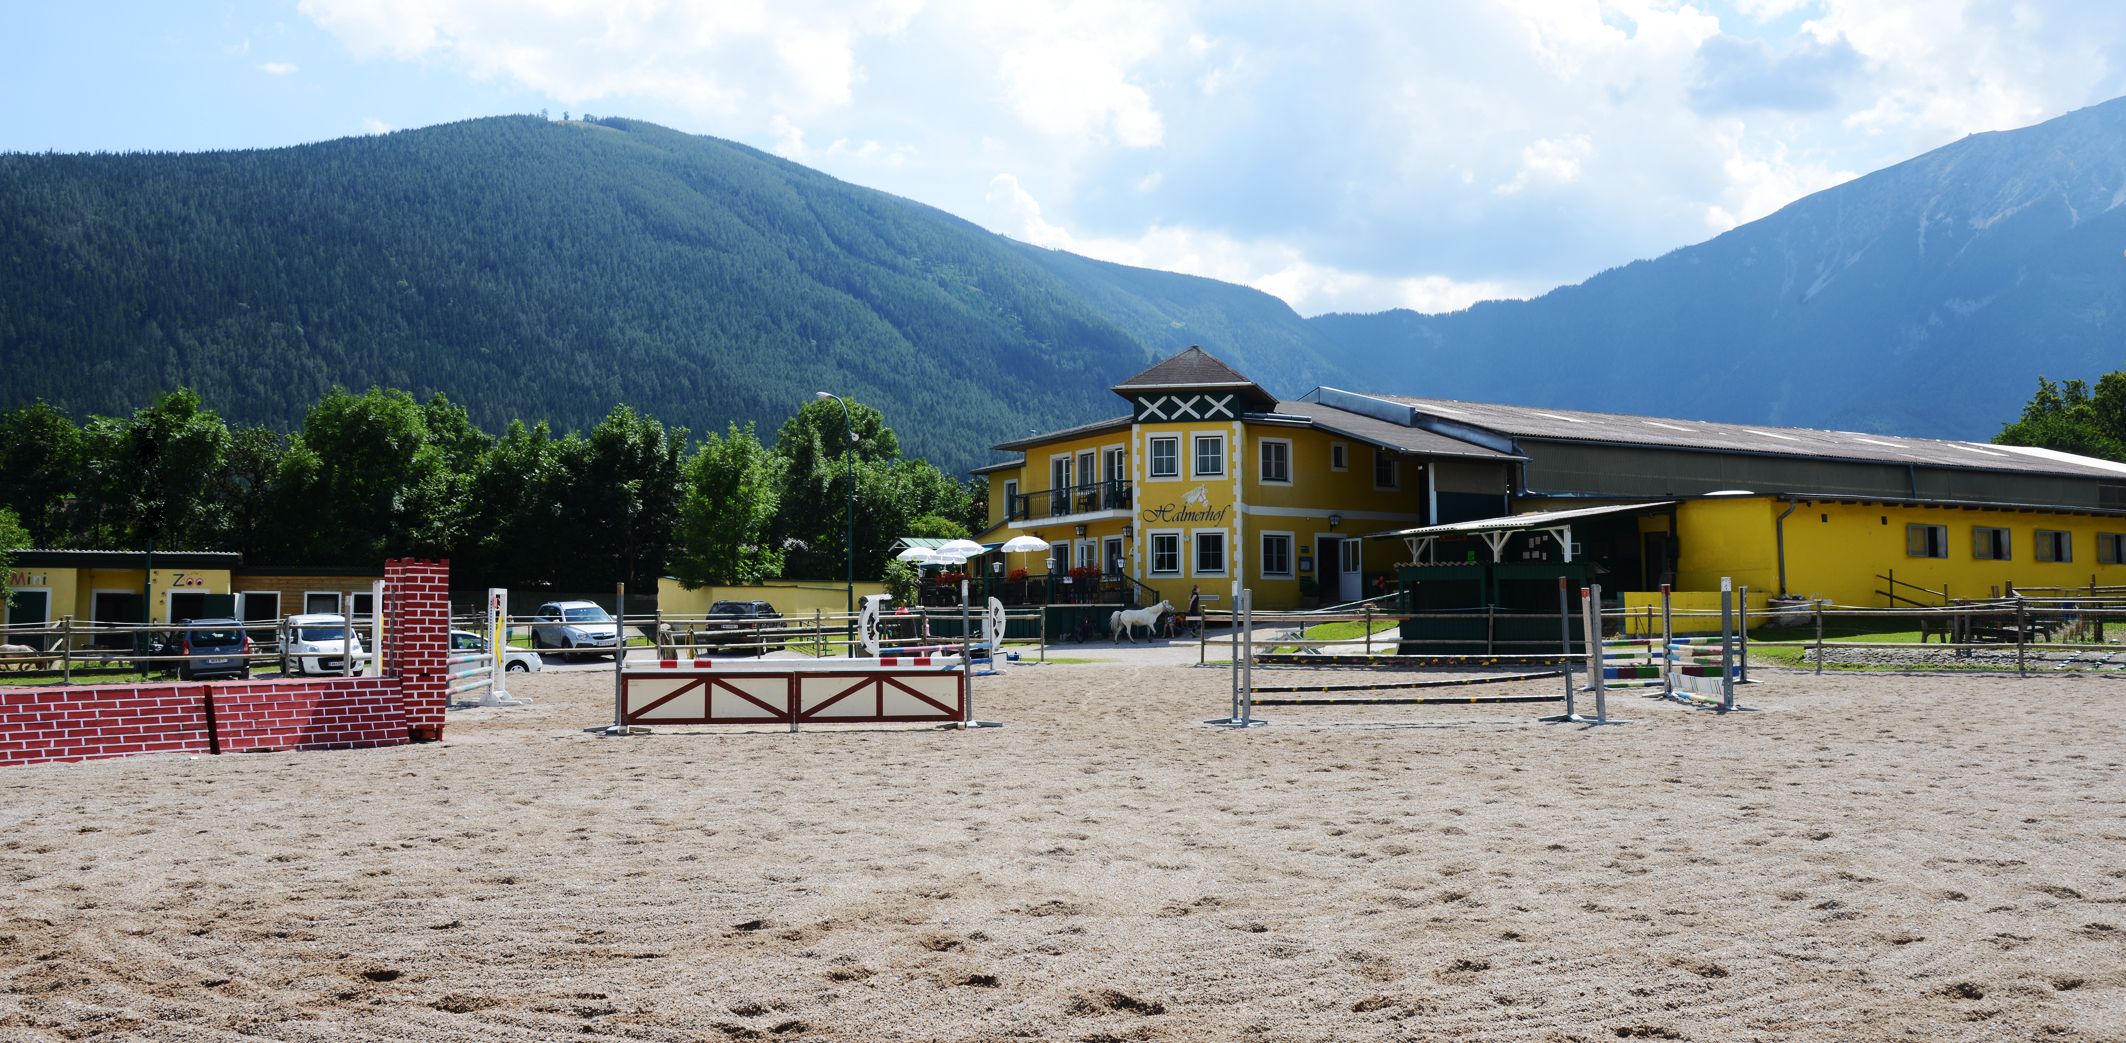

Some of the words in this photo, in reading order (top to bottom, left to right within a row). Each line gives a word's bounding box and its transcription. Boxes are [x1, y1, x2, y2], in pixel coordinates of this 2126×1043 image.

[1142, 503, 1231, 527] Halmerhof
[10, 571, 47, 585] Mini
[172, 573, 204, 587] Zoo
